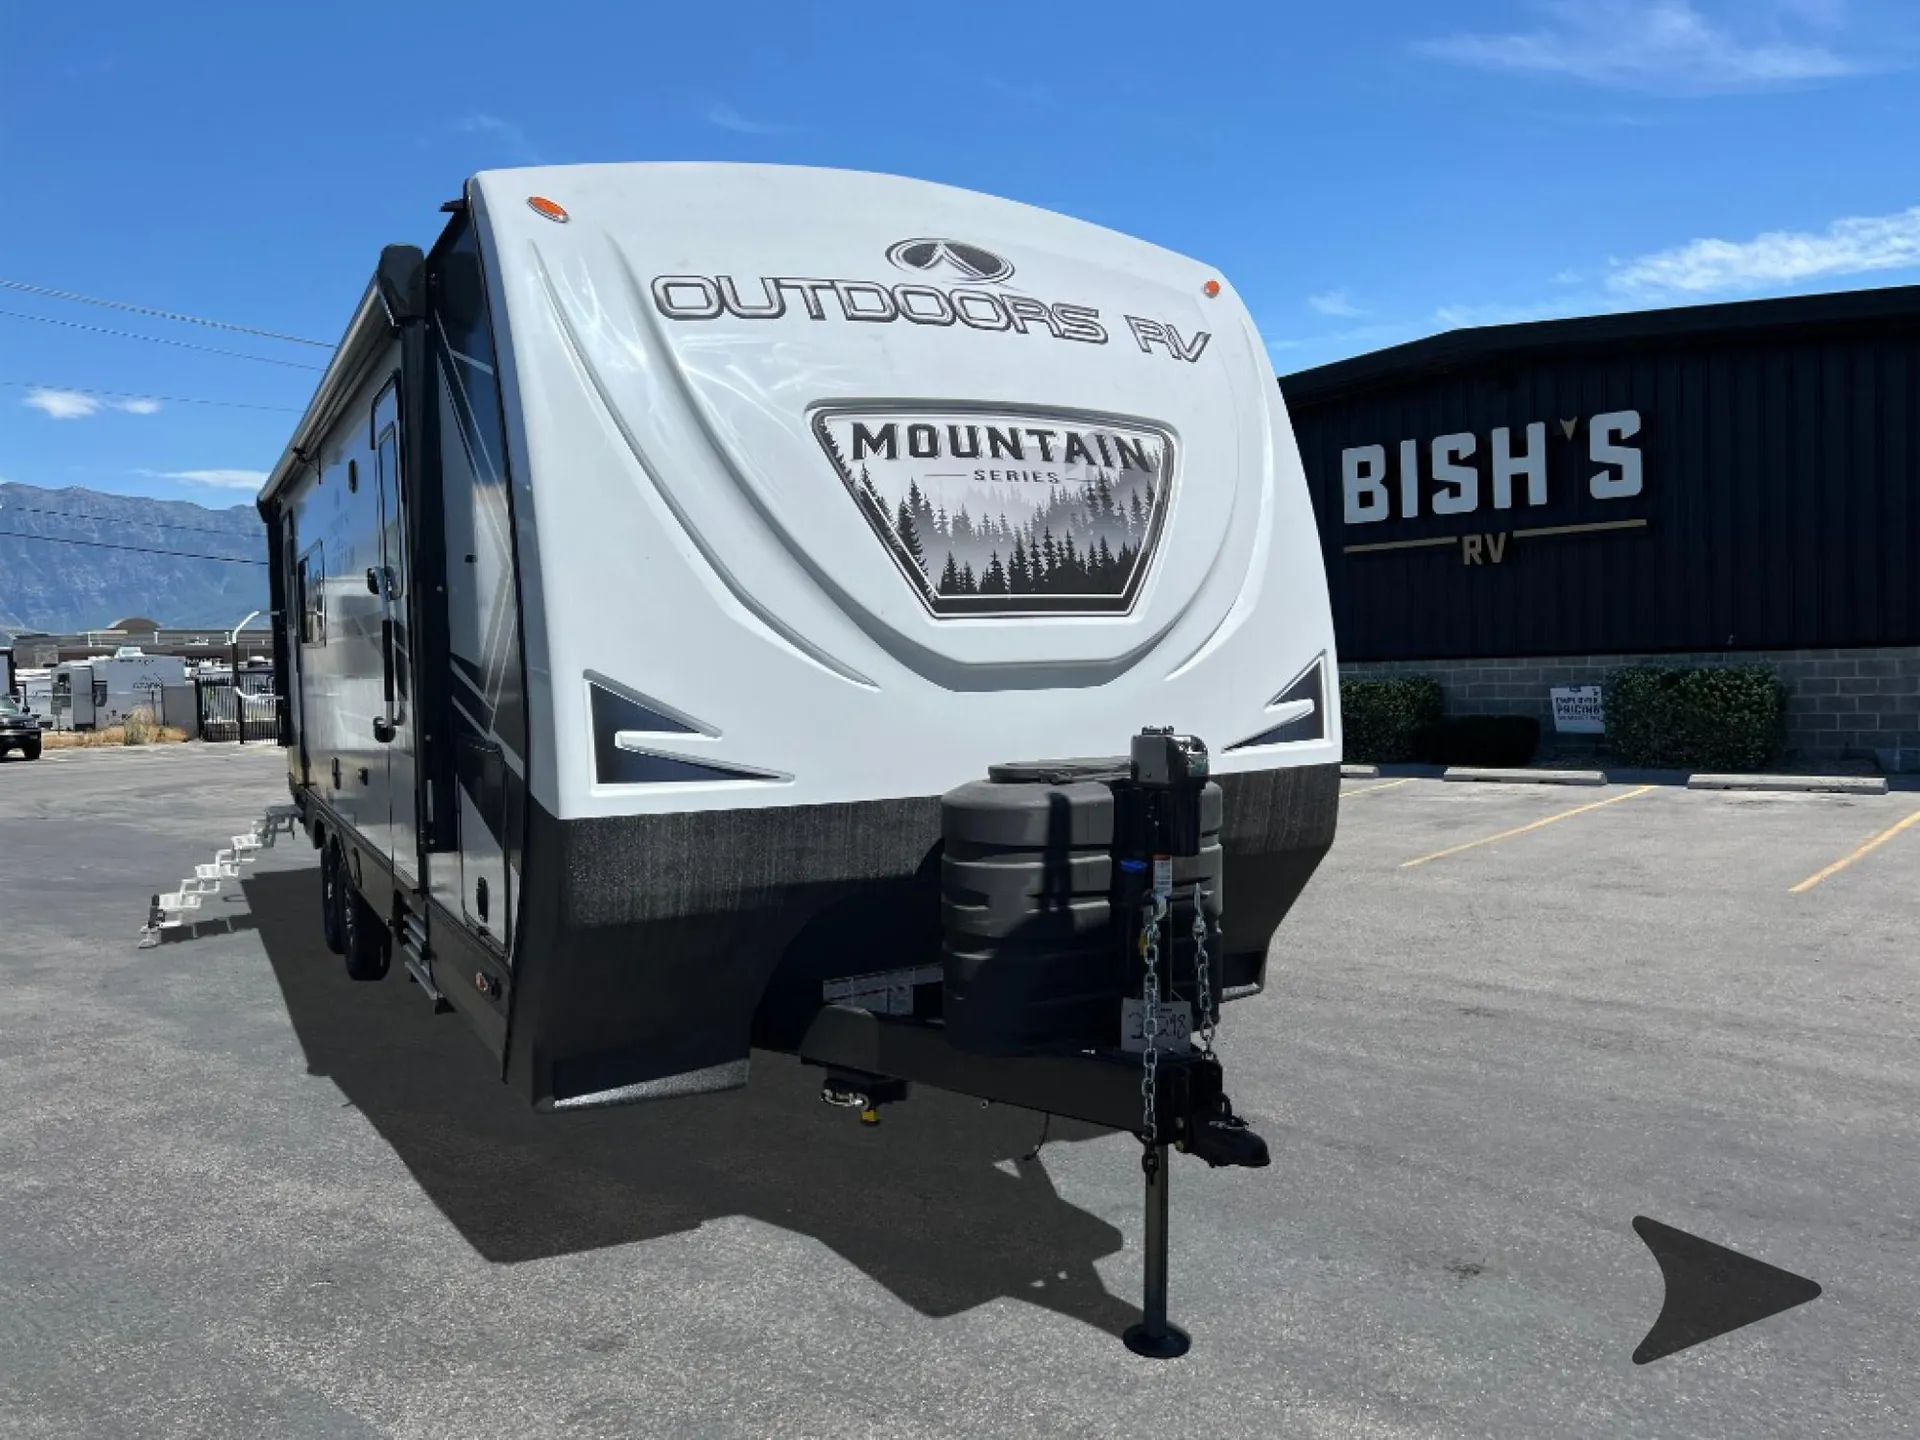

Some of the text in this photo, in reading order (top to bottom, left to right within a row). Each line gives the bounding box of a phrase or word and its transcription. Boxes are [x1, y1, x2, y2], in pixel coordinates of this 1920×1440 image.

[651, 275, 1210, 363] OUTDOORS RV
[851, 421, 1153, 473] MOUNTAIN
[1342, 410, 1643, 524] BISH'S
[973, 469, 1060, 485] SERIES
[1463, 532, 1506, 565] RV
